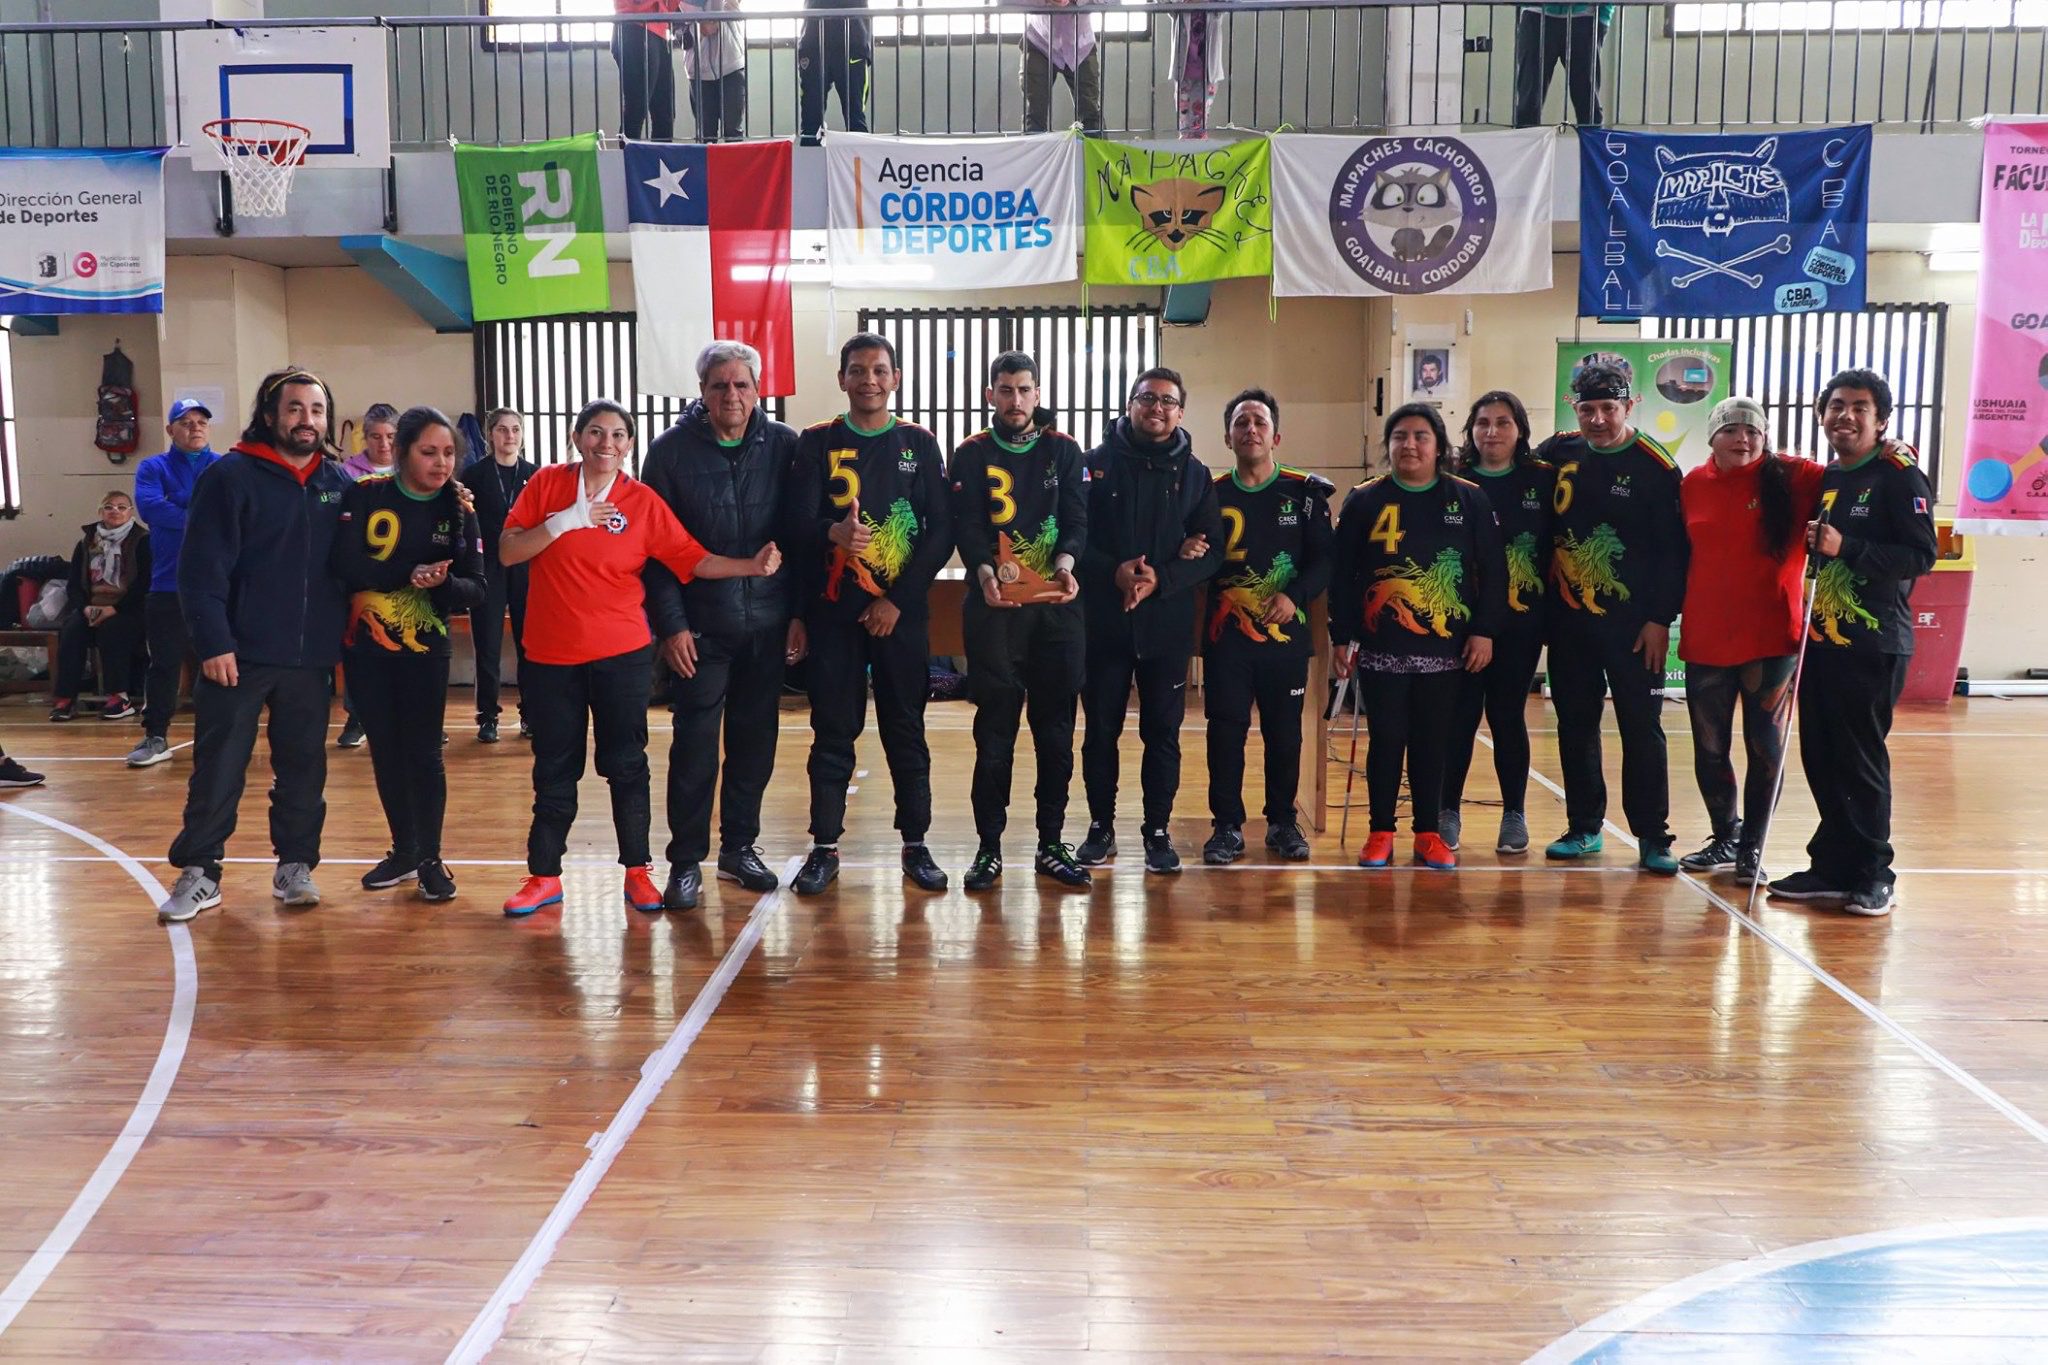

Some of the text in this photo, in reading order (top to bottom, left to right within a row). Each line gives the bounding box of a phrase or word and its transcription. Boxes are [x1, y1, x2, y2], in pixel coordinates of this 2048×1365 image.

[2010, 146, 2048, 155] TORNE
[878, 156, 984, 189] Agencia
[1339, 138, 1487, 208] MAPACHES CACHORROS
[77, 190, 142, 205] General
[499, 174, 518, 255] GOBIERNO
[880, 186, 1039, 222] CÓRDOBA
[21, 210, 98, 226] Deportes
[485, 175, 498, 196] DE
[492, 231, 507, 285] NEGRO
[518, 168, 580, 278] RN
[881, 217, 1053, 255] DEPORTES
[1129, 255, 1184, 281] CBA
[1345, 234, 1482, 286] GOALBALL CORDOBA
[1808, 265, 1847, 283] DEPORTES
[1786, 287, 1812, 301] CBA
[1648, 348, 1678, 362] Charlas
[1973, 413, 2025, 421] ARGENTINA
[1974, 399, 2027, 408] USHUAIA
[828, 448, 861, 508] 5
[986, 465, 1017, 525] 3
[1553, 460, 1580, 515] 6
[366, 508, 401, 562] 9
[1221, 505, 1248, 561] 2
[1369, 503, 1406, 555] 4
